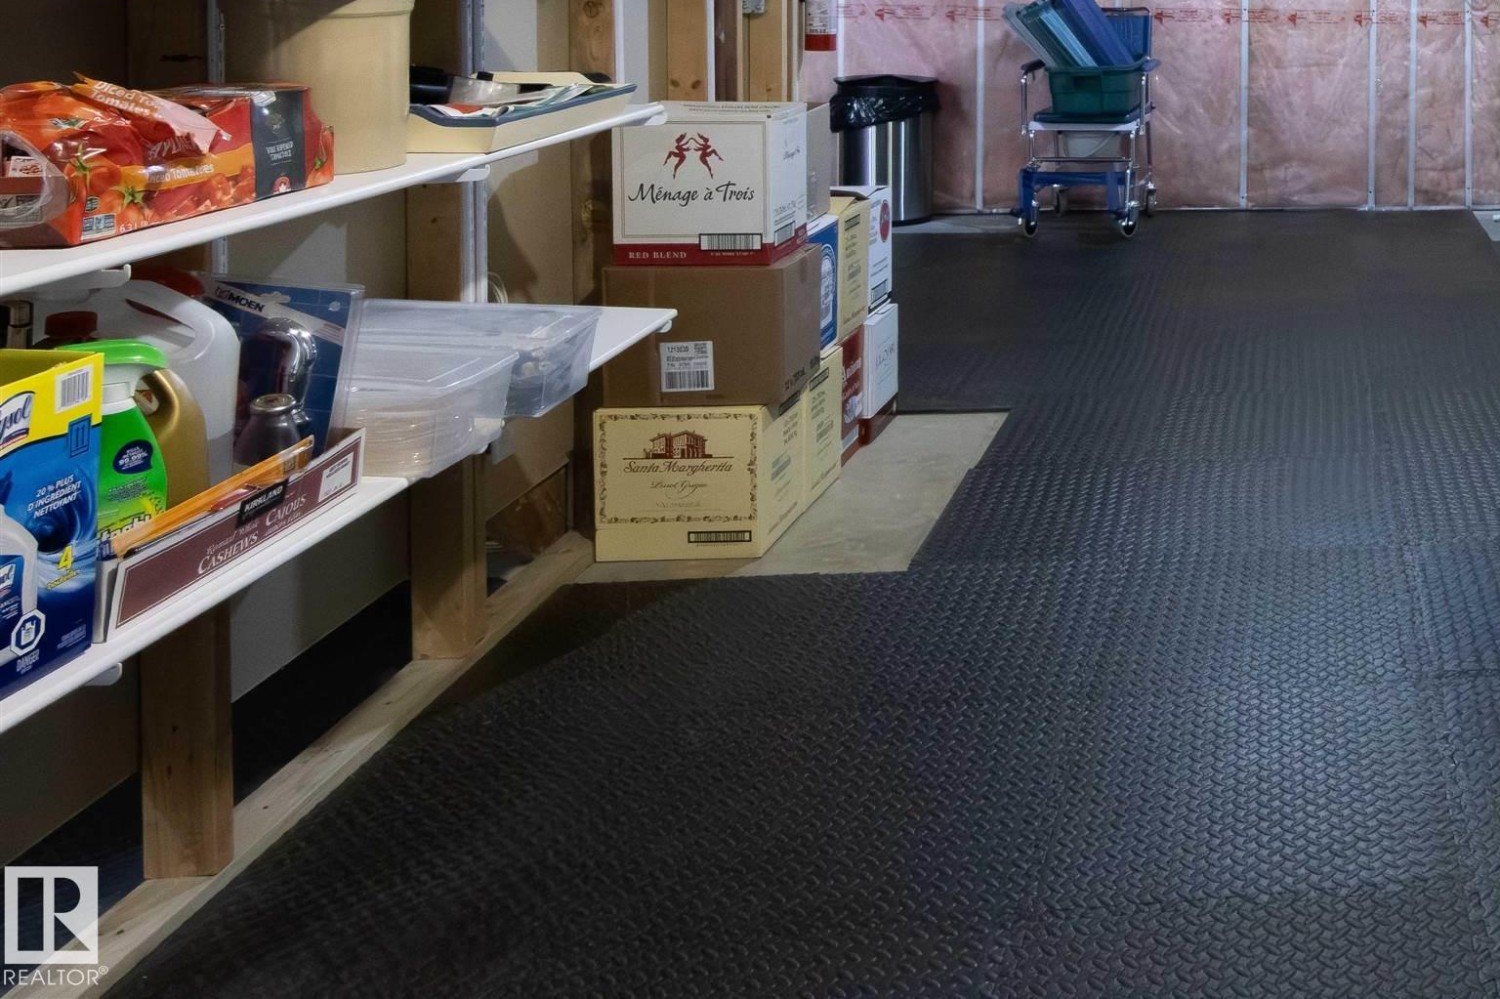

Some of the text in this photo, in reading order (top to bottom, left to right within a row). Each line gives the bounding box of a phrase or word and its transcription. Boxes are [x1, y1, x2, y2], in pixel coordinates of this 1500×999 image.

[94, 81, 136, 100] Diced
[627, 180, 755, 207] Ménage à Trois
[628, 251, 687, 259] RED BLEND
[228, 292, 266, 313] MOEN
[0, 394, 33, 443] ysol
[623, 460, 734, 477] Santa Margherita
[55, 474, 75, 489] PLUS
[244, 484, 284, 513] KIRKLAND
[57, 545, 73, 570] 4
[197, 530, 260, 575] CASHEWS
